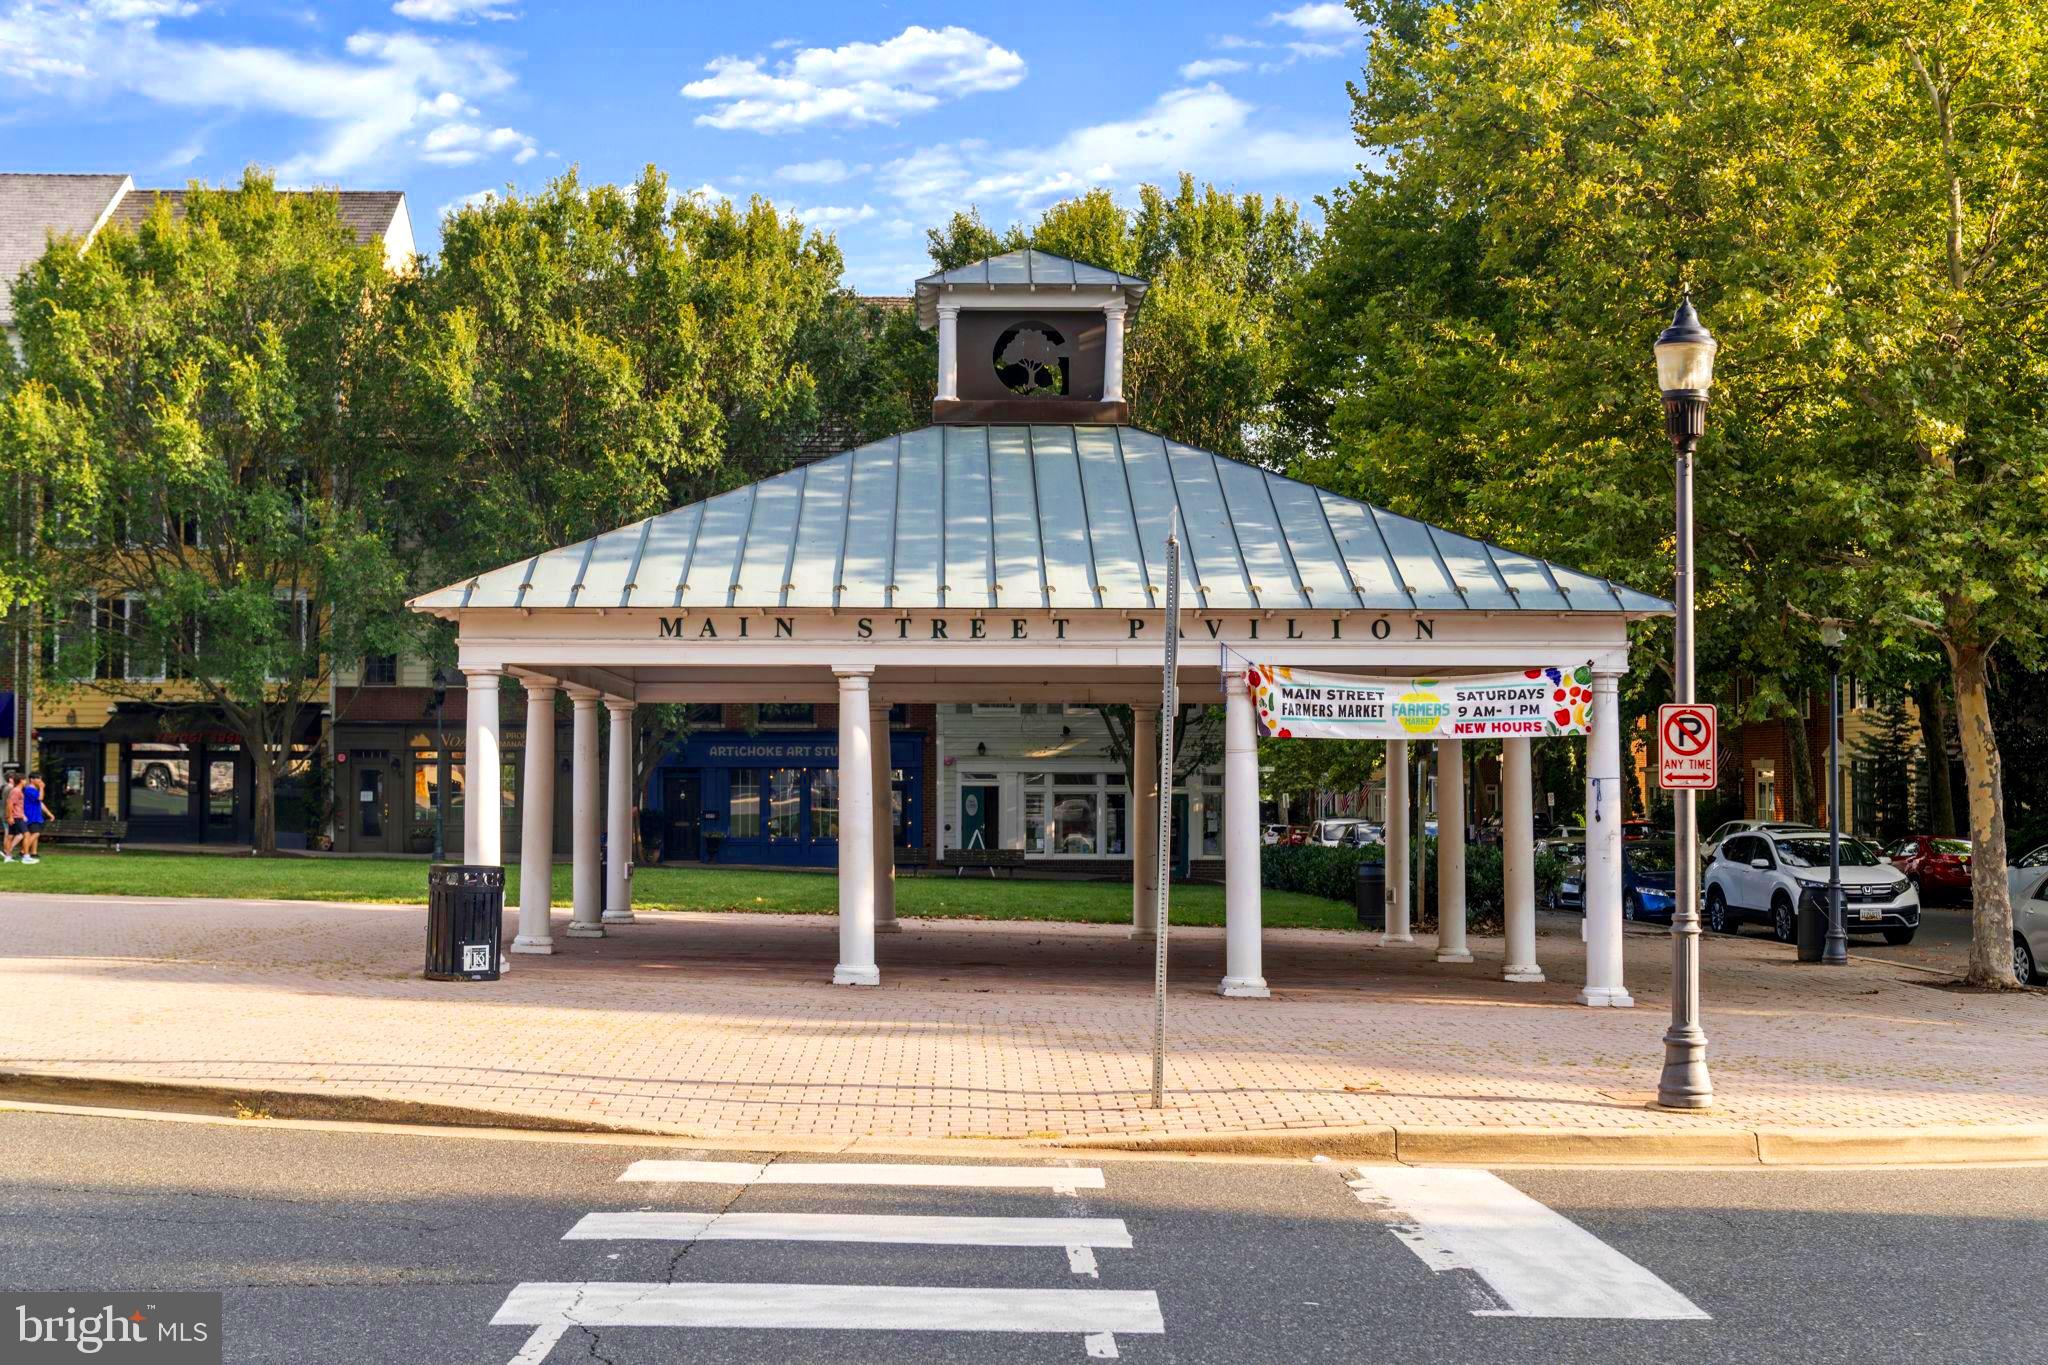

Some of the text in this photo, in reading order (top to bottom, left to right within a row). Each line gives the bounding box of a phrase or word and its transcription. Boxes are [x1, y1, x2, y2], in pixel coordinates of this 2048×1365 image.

[658, 617, 795, 638] MAIN
[857, 617, 1070, 639] STREET
[1282, 688, 1385, 701] MAIN STREET
[1456, 688, 1545, 701] SATURDAYS
[1281, 702, 1385, 718] FARMERS MARKET
[1391, 702, 1450, 717] FARMERS
[1458, 706, 1467, 718] 9
[1509, 705, 1515, 715] 1
[1520, 704, 1540, 715] PM
[1404, 717, 1435, 726] MARKET
[1454, 722, 1543, 734] NEW HOURS
[786, 745, 812, 757] ART
[814, 745, 839, 757] STU
[1664, 759, 1711, 770] ANY TIME
